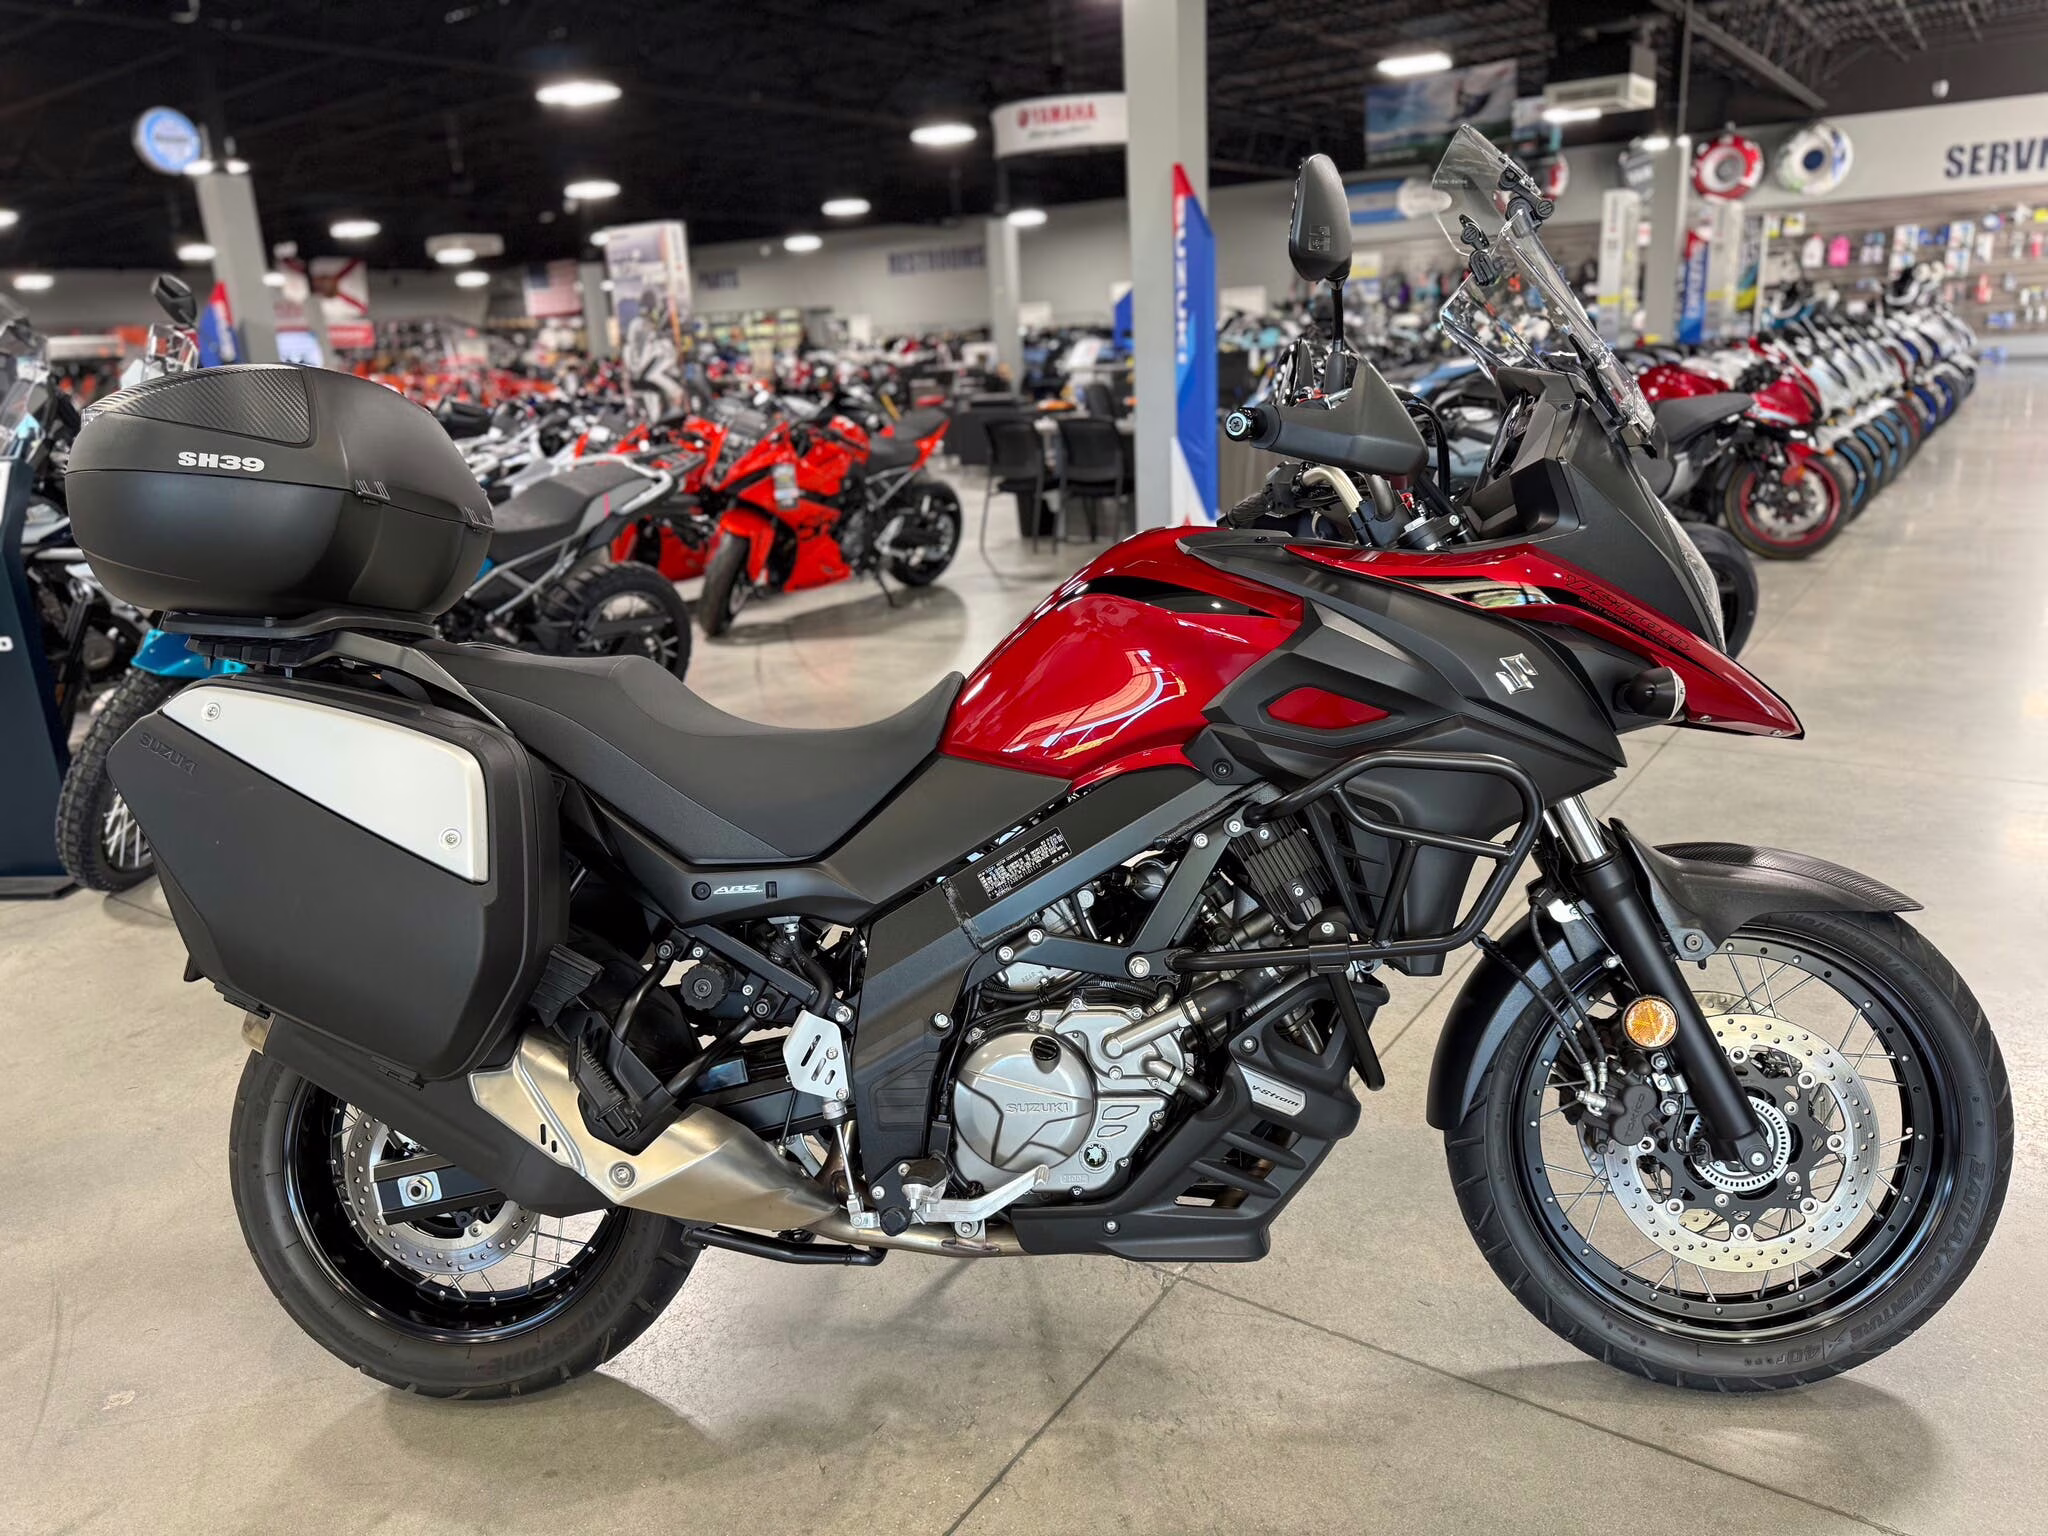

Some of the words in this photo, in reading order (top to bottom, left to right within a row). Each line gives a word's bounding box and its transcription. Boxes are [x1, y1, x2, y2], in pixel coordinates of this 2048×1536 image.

[178, 451, 265, 472] SH39
[139, 732, 198, 777] SUZUKI
[713, 884, 761, 895] ABS
[1252, 1084, 1299, 1107] V-Strom
[1005, 1102, 1069, 1113] SUZUKI
[1624, 1092, 1646, 1138] TOKICO
